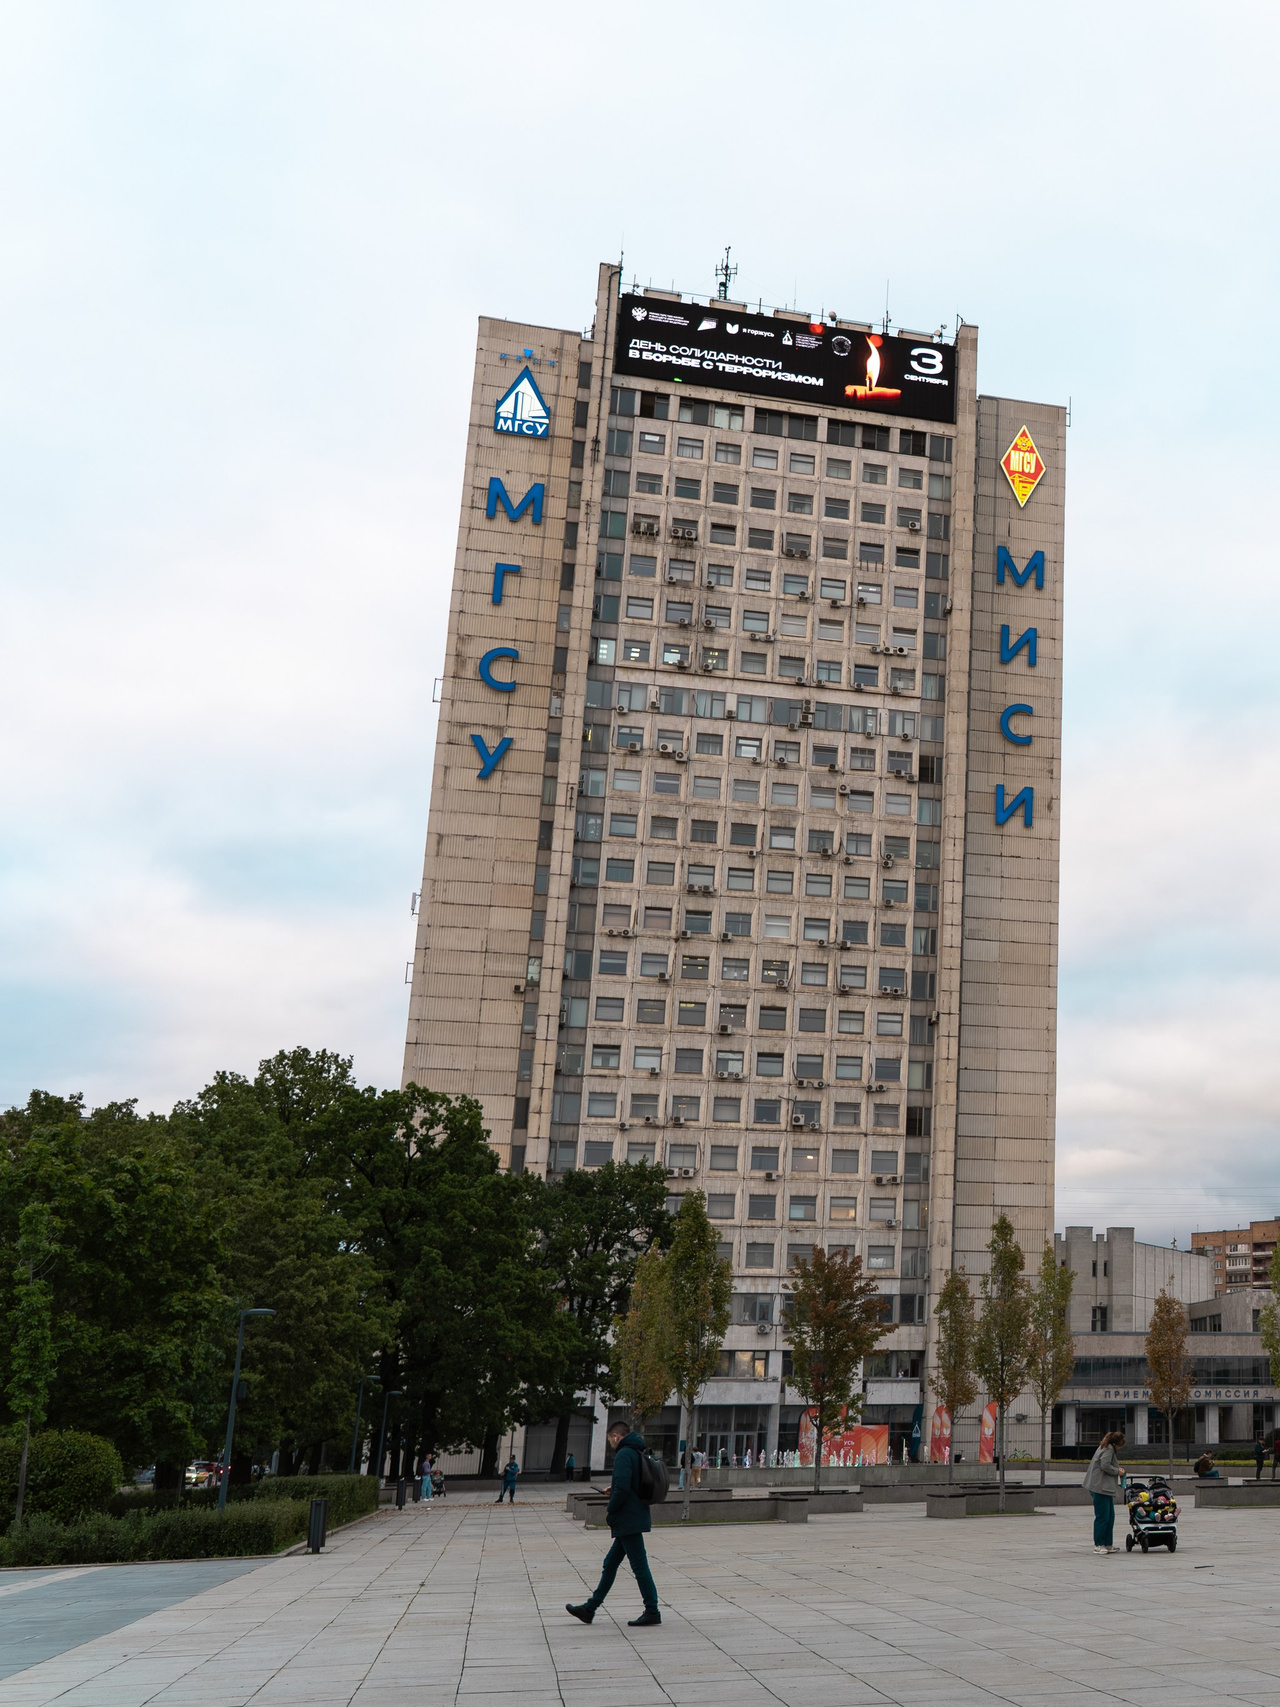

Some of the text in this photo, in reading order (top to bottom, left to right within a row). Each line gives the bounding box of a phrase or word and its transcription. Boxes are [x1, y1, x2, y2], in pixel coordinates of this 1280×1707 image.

[747, 328, 775, 338] горжусь
[628, 349, 824, 387] В БОРЬБЕ С ТЕРРОРИЗМОМ
[629, 338, 783, 370] ДЕНЬ СОЛИДАРНОСТИ
[910, 347, 943, 375] 3
[903, 374, 949, 386] СЕНТЯБРЯ
[497, 418, 548, 435] МГСУ
[1009, 449, 1037, 474] МГСУ
[470, 475, 545, 779] МГСУ
[994, 544, 1046, 829] МИСИ
